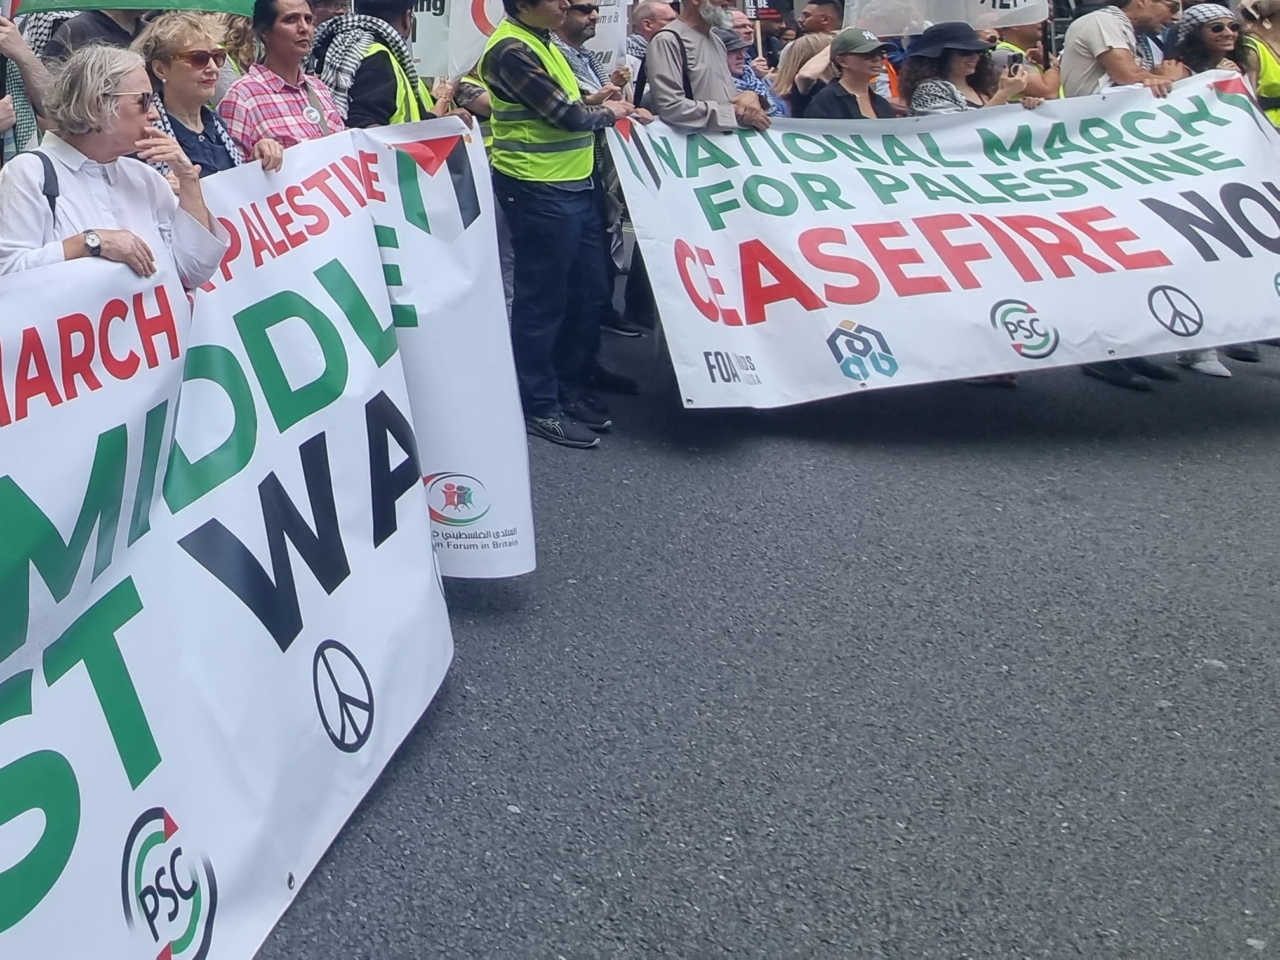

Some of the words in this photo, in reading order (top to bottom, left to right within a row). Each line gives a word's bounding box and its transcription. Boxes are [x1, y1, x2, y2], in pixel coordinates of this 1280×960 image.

[648, 128, 974, 179] NATIONAL
[976, 95, 1232, 165] MARCH
[693, 172, 856, 231] FOR
[856, 143, 1246, 206] PALESTINE
[674, 206, 1174, 327] CEASEFIRE
[1139, 181, 1280, 262] NO
[1004, 318, 1049, 341] PSC
[177, 390, 421, 653] WA
[447, 541, 478, 550] Forum
[139, 847, 198, 943] PSC
